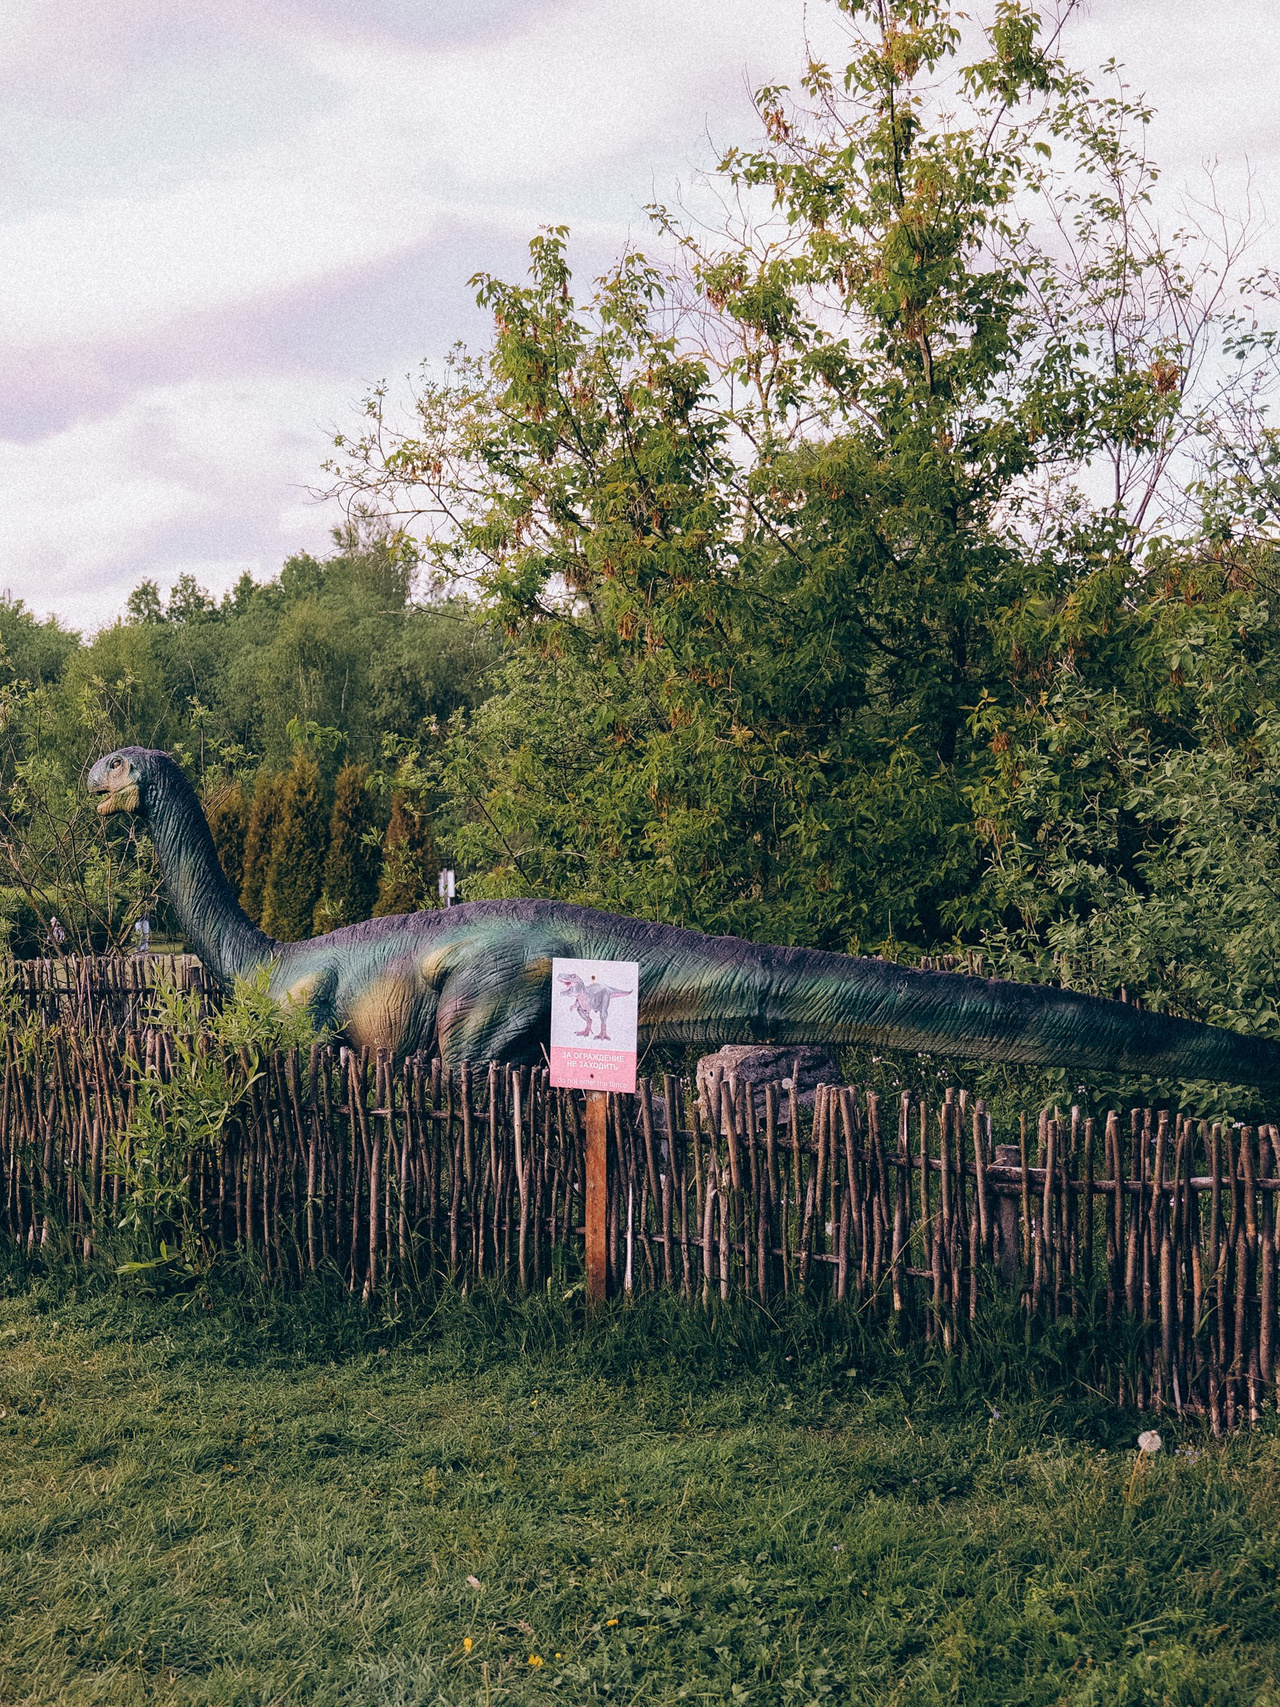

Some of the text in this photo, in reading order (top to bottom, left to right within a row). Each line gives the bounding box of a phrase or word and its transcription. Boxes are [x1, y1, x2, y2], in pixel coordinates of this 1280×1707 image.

[573, 1052, 624, 1062] ОГРАЖДЕНИЕ
[579, 1061, 618, 1070] ЗАХОДИТЬ
[609, 1080, 627, 1089] fence
